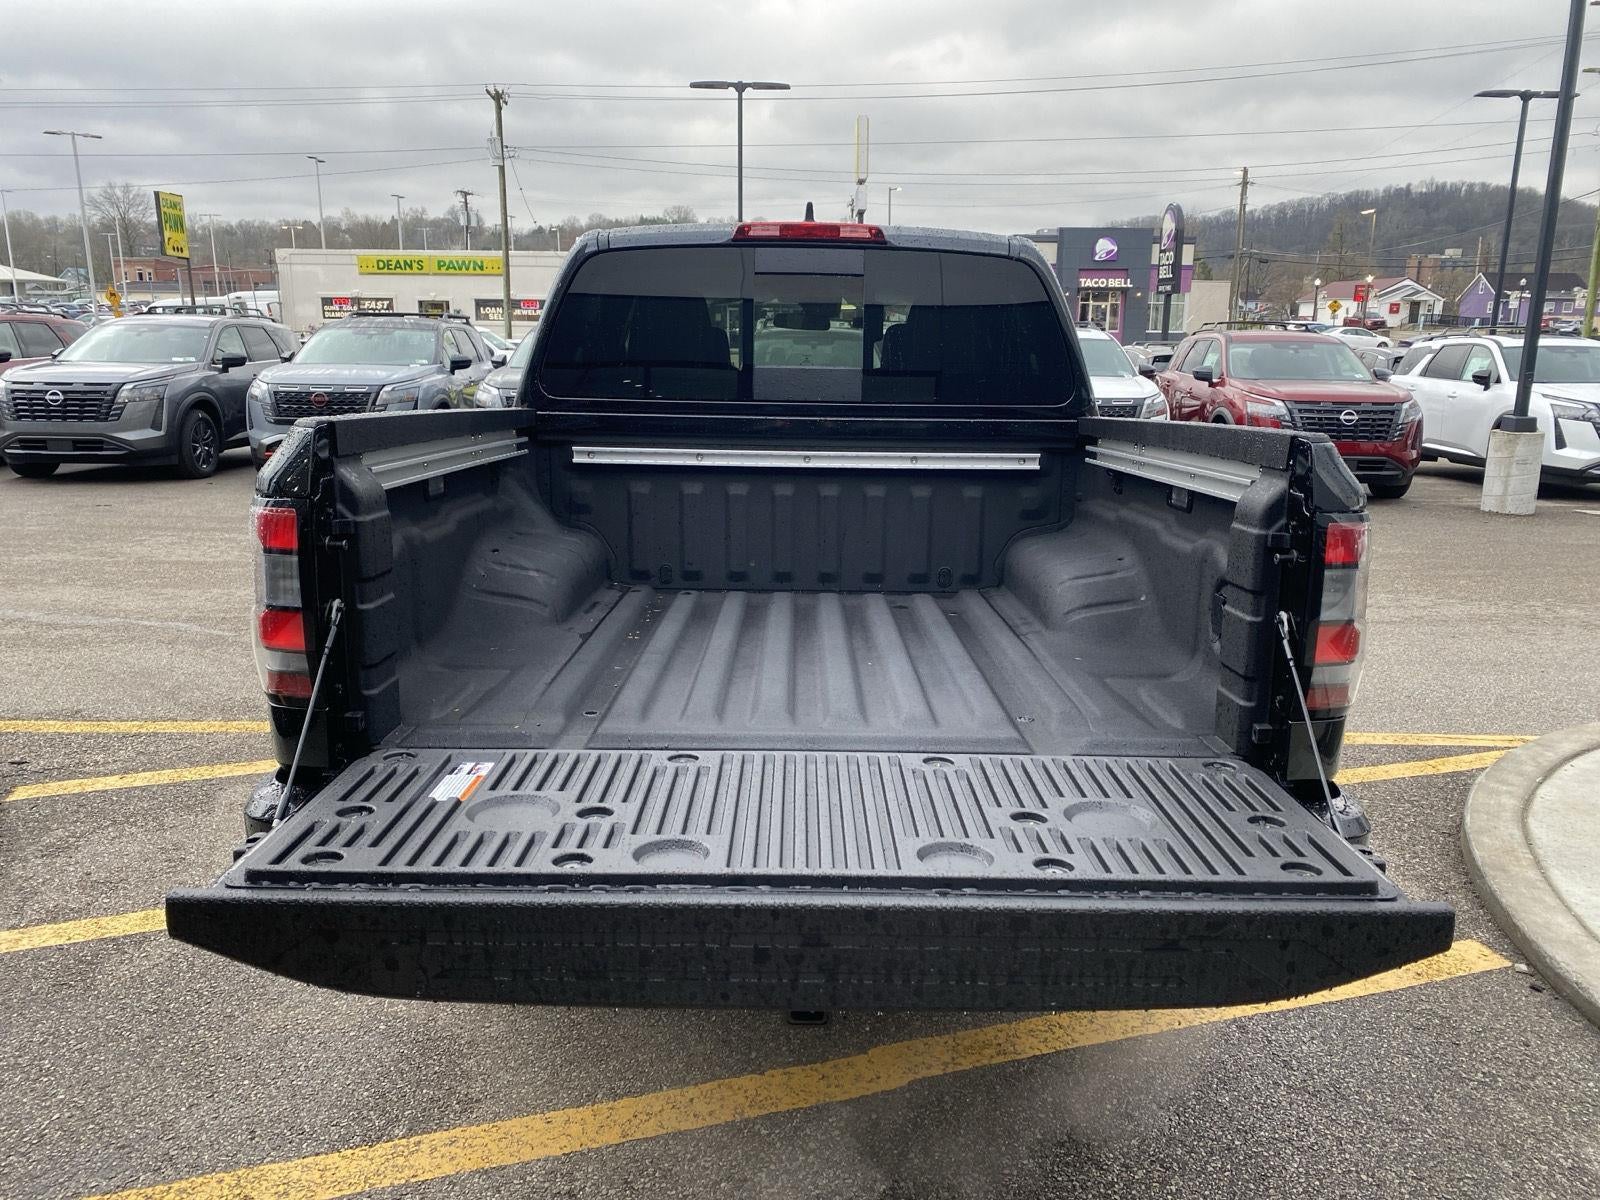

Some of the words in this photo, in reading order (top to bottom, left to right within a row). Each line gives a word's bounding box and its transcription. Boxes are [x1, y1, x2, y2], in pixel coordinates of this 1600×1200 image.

[163, 211, 185, 233] PAWN
[1159, 251, 1174, 265] TACO
[1158, 265, 1173, 279] BELL
[1080, 278, 1107, 288] TACO
[1108, 278, 1133, 288] BELL
[364, 300, 390, 310] FAST
